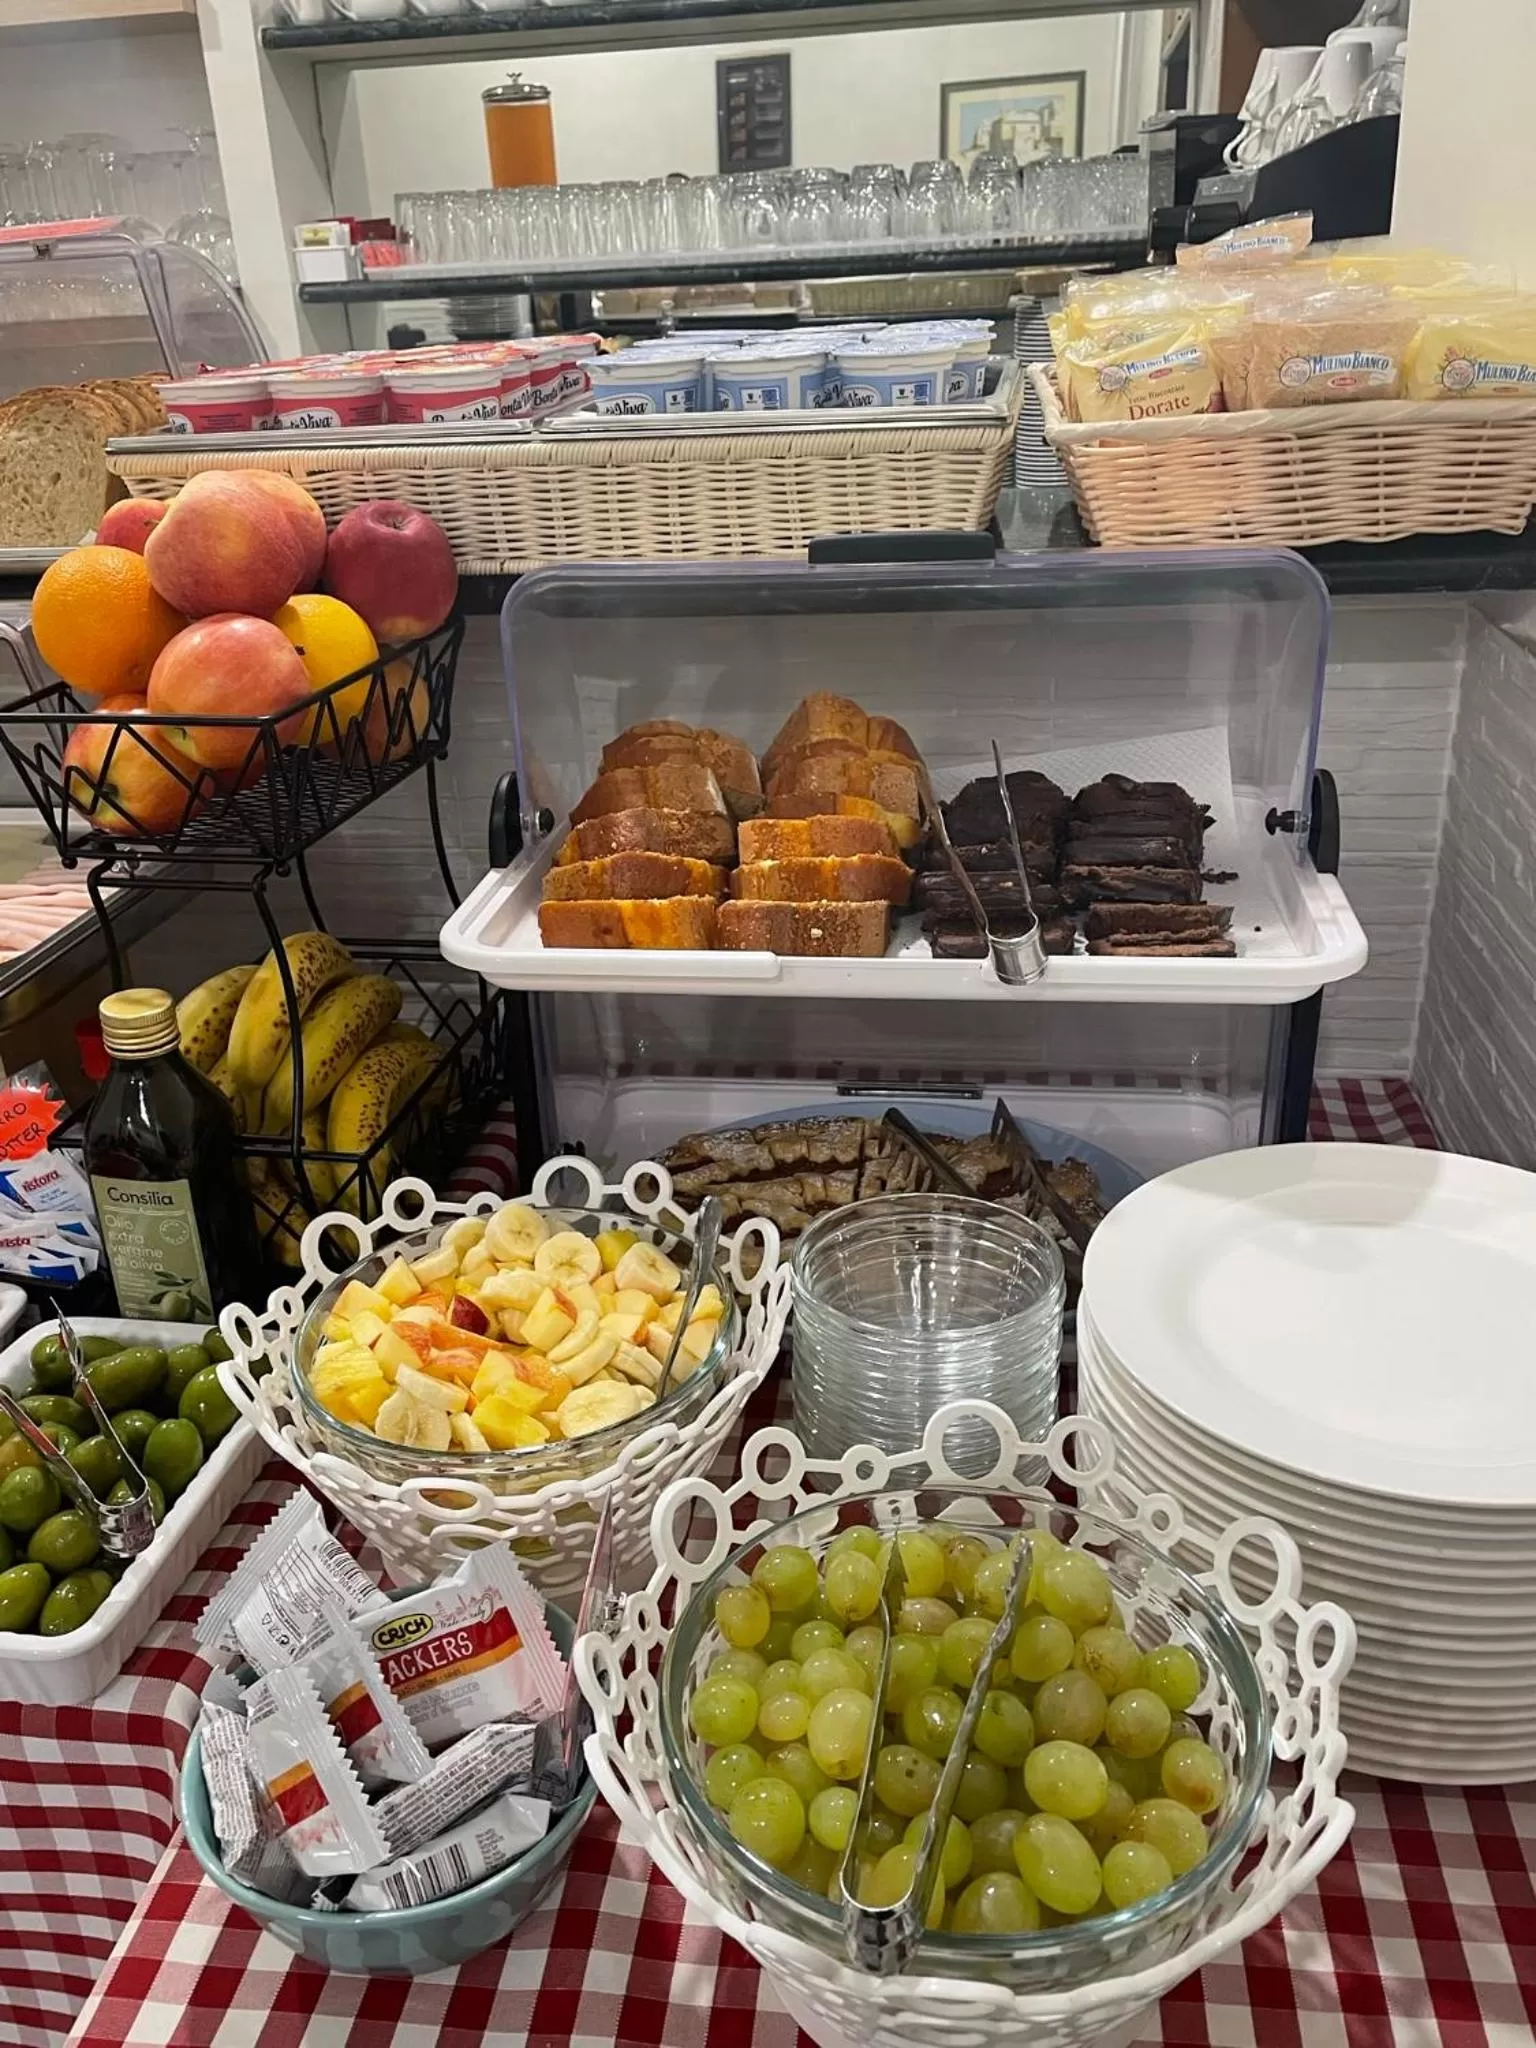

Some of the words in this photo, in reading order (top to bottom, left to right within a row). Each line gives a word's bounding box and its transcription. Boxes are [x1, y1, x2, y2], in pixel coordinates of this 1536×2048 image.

[1313, 354, 1352, 374] MULINO
[1352, 351, 1389, 370] BIANCO
[1476, 361, 1517, 381] MULINO
[1128, 396, 1190, 420] Dorate
[22, 1170, 60, 1192] ristora
[106, 1186, 174, 1206] Consilia
[105, 1214, 134, 1230] Olio
[107, 1231, 145, 1244] extra
[114, 1256, 127, 1268] di
[130, 1258, 165, 1272] oliva
[377, 1617, 429, 1647] CRICH
